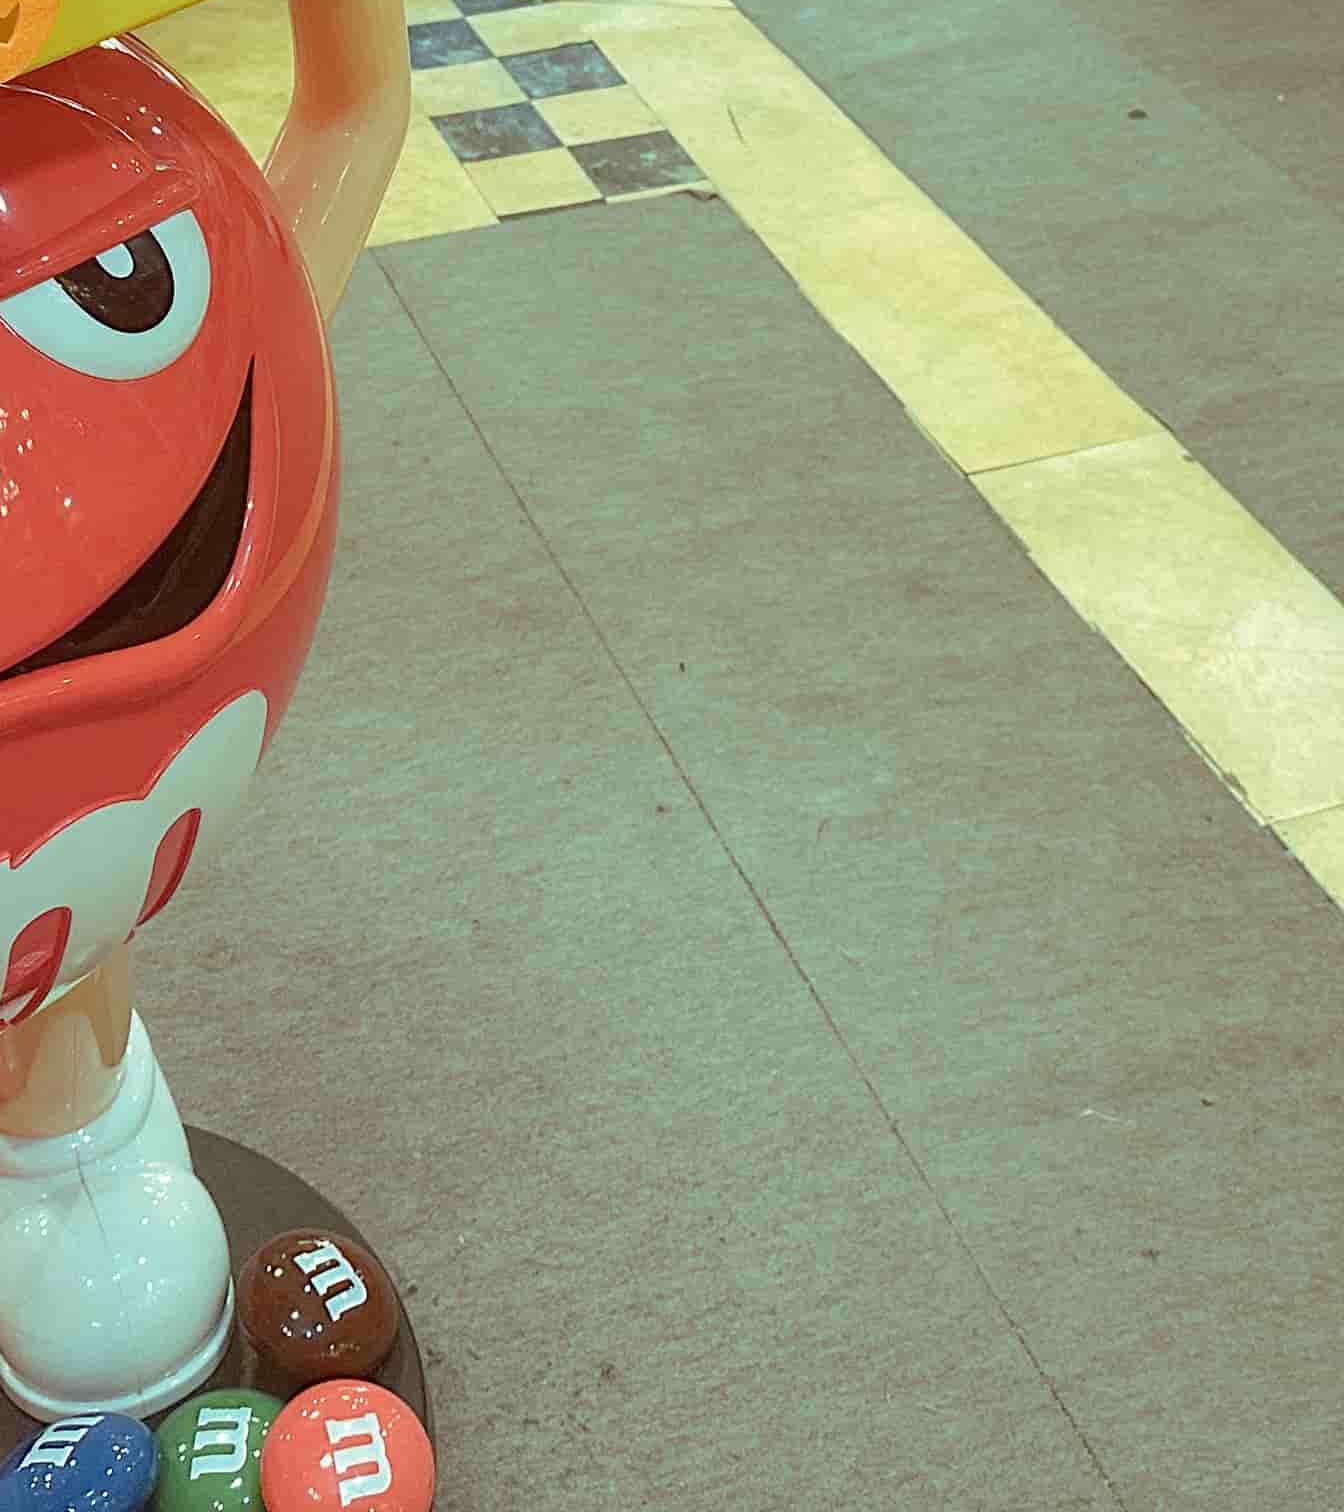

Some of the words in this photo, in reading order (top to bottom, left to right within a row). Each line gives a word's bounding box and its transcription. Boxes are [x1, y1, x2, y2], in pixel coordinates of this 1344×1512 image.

[294, 1241, 368, 1322] m
[23, 1412, 105, 1468] m
[191, 1406, 252, 1479] m
[326, 1412, 393, 1507] m
